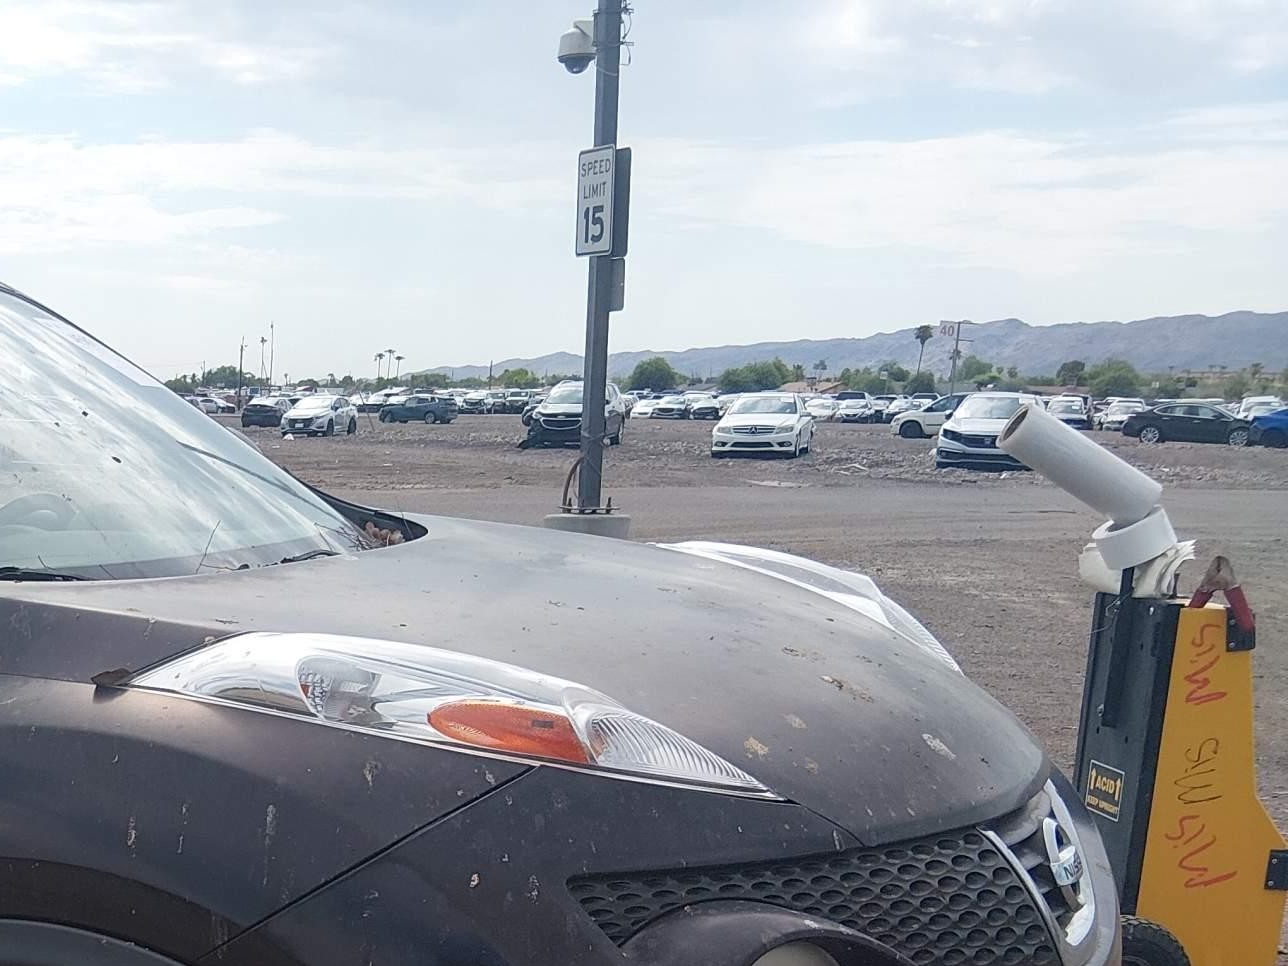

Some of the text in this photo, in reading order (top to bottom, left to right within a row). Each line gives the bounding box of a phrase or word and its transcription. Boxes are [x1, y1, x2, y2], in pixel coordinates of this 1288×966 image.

[581, 158, 611, 177] SPEED
[583, 181, 607, 199] LIMIT
[583, 204, 605, 244] 15
[939, 325, 955, 337] 40
[1095, 775, 1115, 794] ACID
